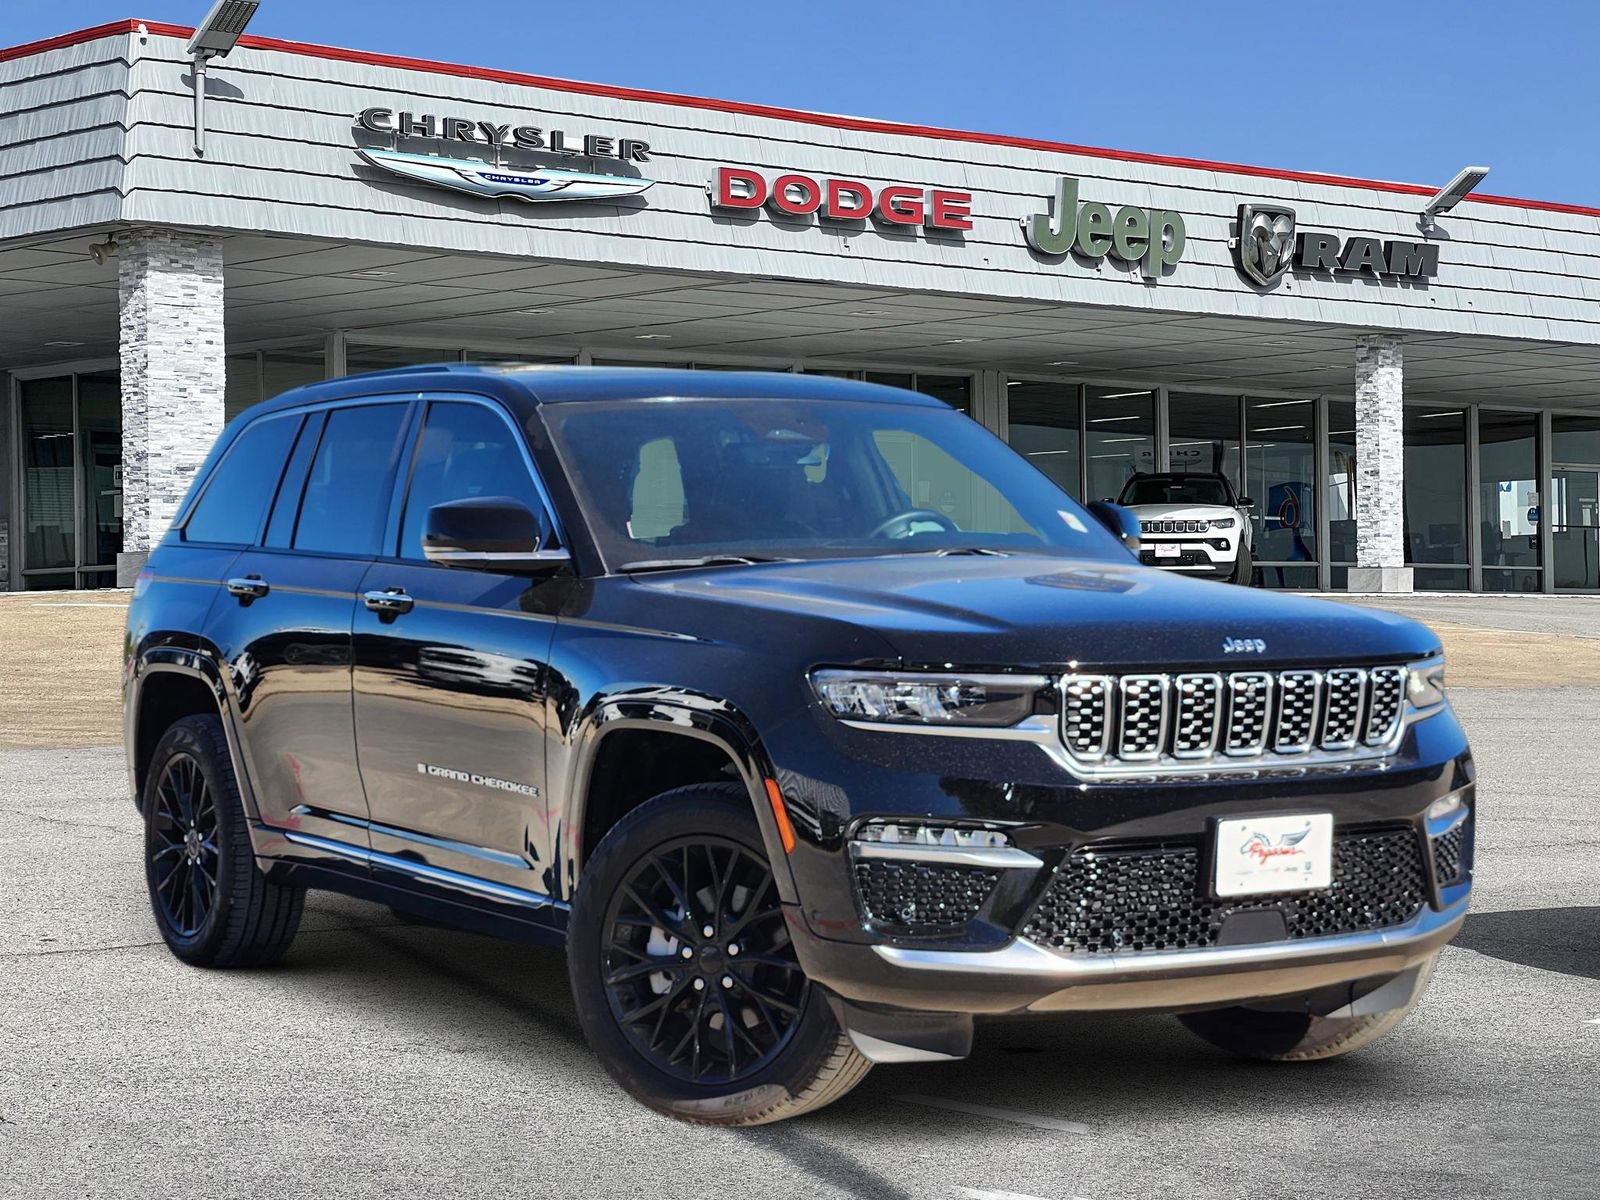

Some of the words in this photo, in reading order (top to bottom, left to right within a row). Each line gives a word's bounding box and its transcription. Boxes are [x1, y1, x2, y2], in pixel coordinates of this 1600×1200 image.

[359, 107, 651, 162] CHRYSLER
[484, 174, 541, 184] CHRYSLER
[712, 166, 973, 231] DODGE
[1029, 176, 1186, 278] Jeep
[1298, 232, 1440, 277] RAM
[1222, 636, 1266, 653] Jeep
[428, 765, 469, 782] GRAND
[471, 775, 537, 797] CHEROKEE
